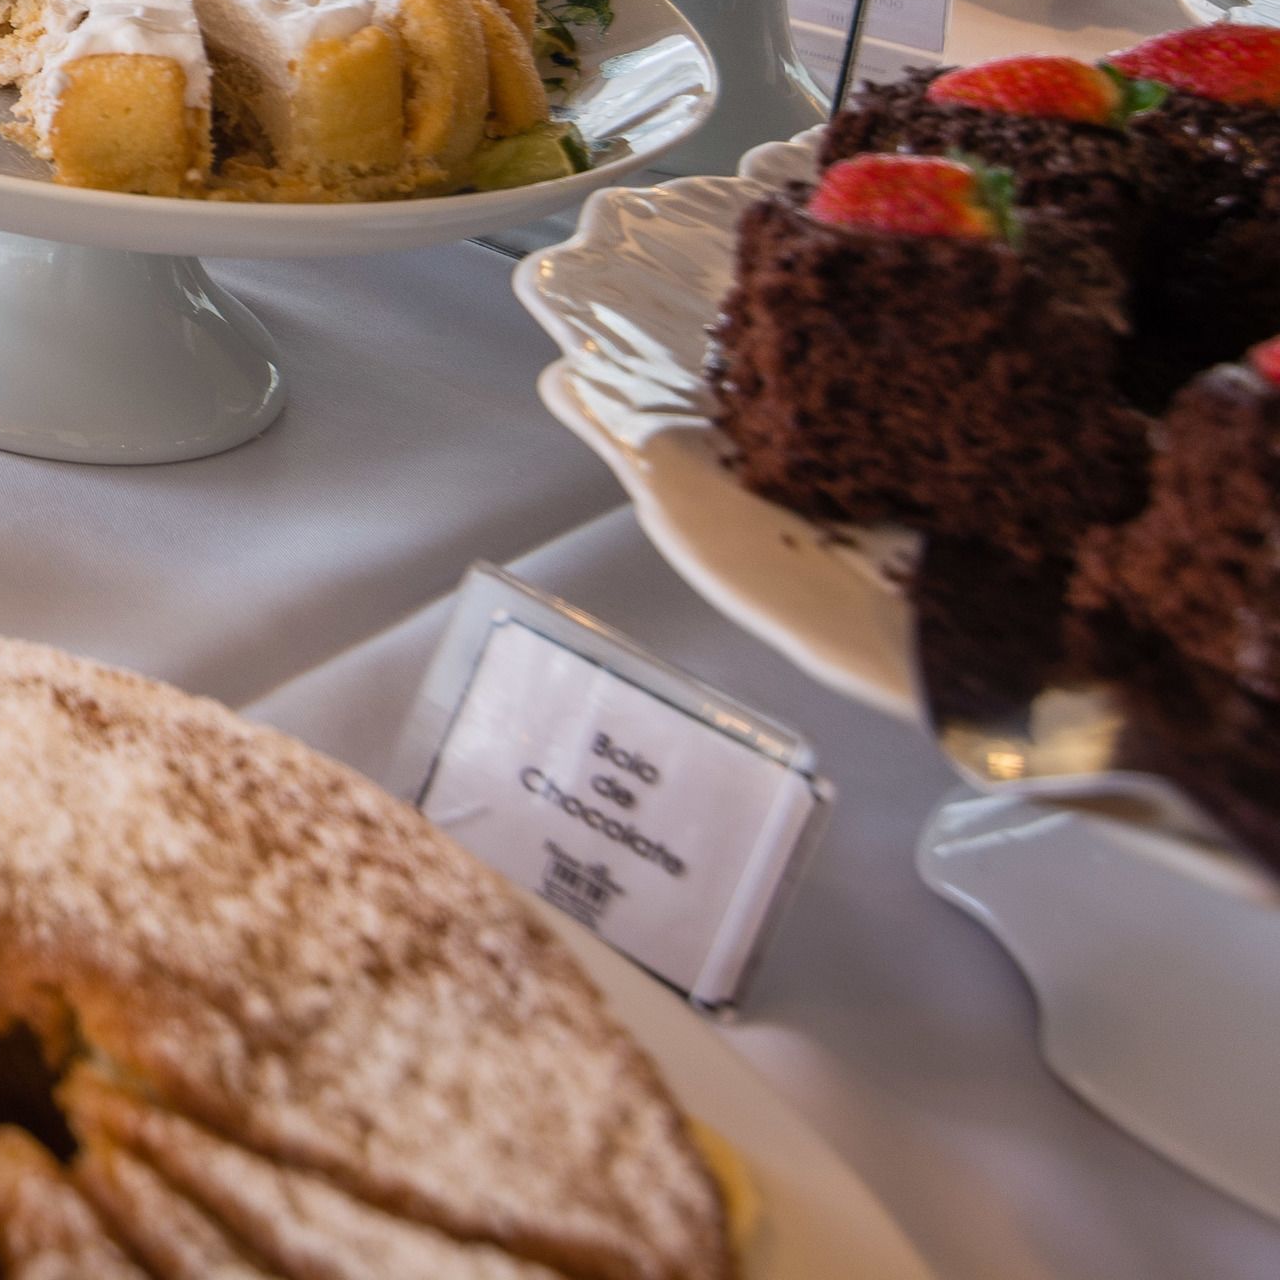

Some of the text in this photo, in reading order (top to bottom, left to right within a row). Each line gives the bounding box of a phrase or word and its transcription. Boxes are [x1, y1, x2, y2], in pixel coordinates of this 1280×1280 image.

[592, 732, 659, 784] Bolo
[591, 775, 637, 809] de
[520, 766, 687, 876] Chocolate
